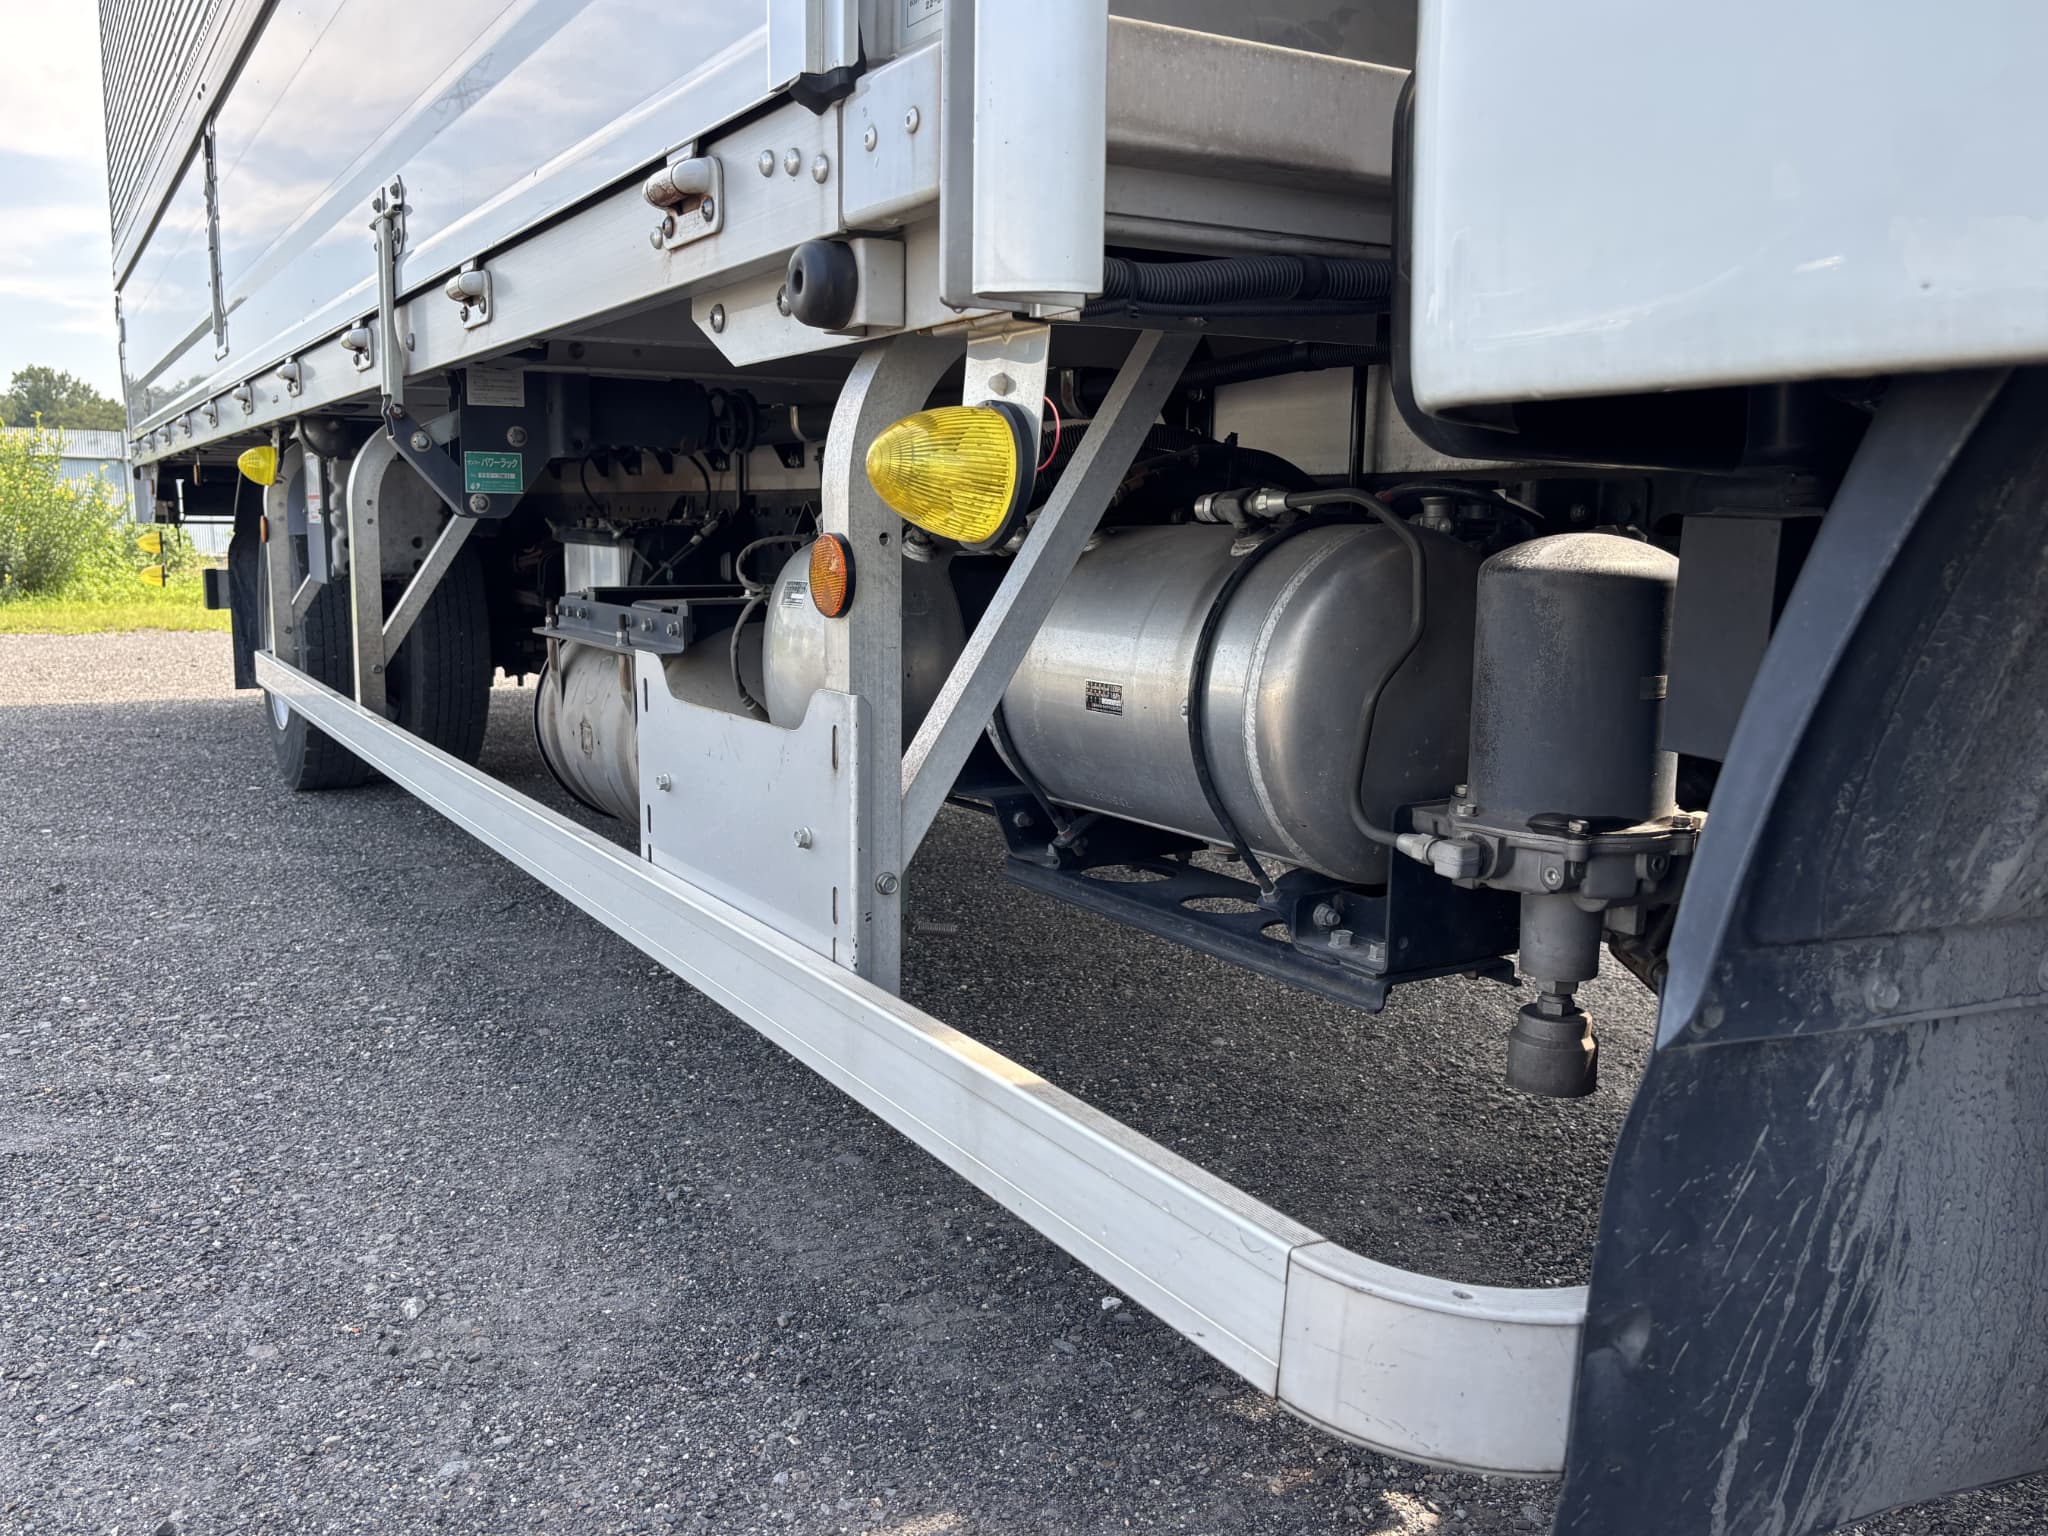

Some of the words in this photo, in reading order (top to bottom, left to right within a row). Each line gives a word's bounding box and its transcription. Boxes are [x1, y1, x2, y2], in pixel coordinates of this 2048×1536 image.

[481, 457, 518, 469] パワーラック
